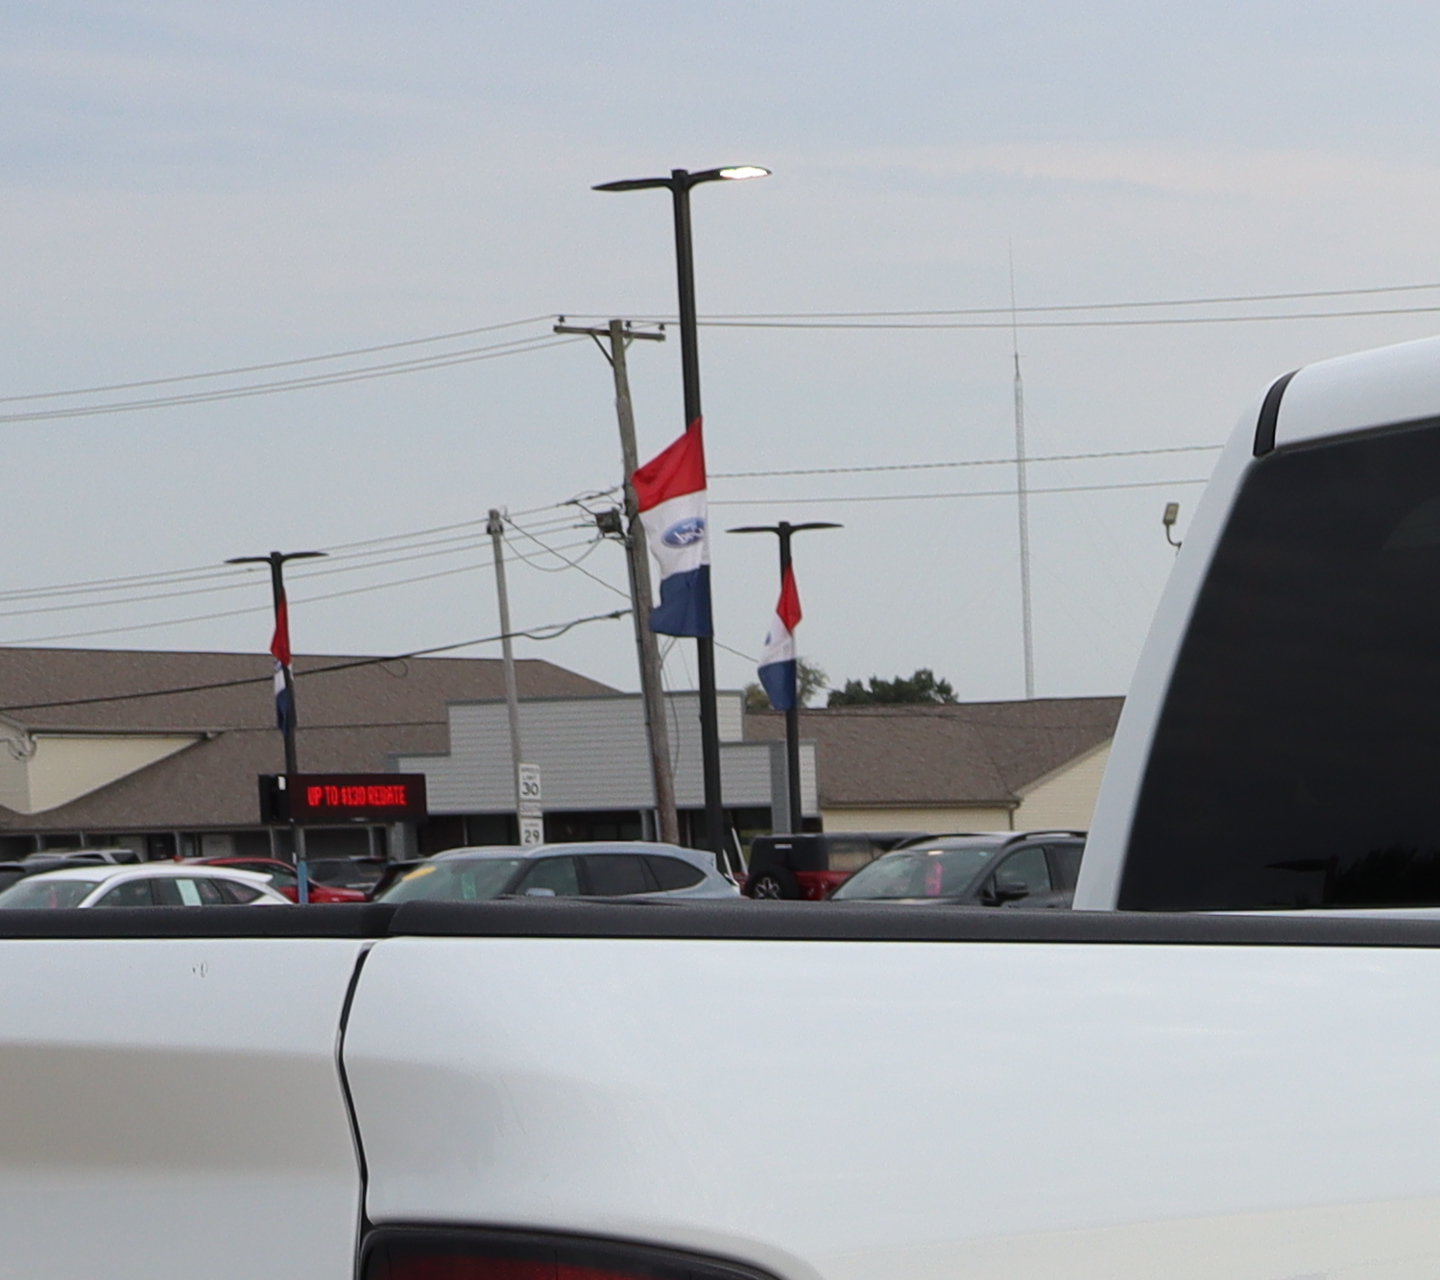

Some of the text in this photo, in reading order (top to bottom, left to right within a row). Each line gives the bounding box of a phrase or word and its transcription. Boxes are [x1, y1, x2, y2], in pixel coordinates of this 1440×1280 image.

[306, 786, 322, 806] UP
[325, 785, 338, 806] TO
[522, 781, 539, 797] 30
[524, 829, 540, 844] 29
